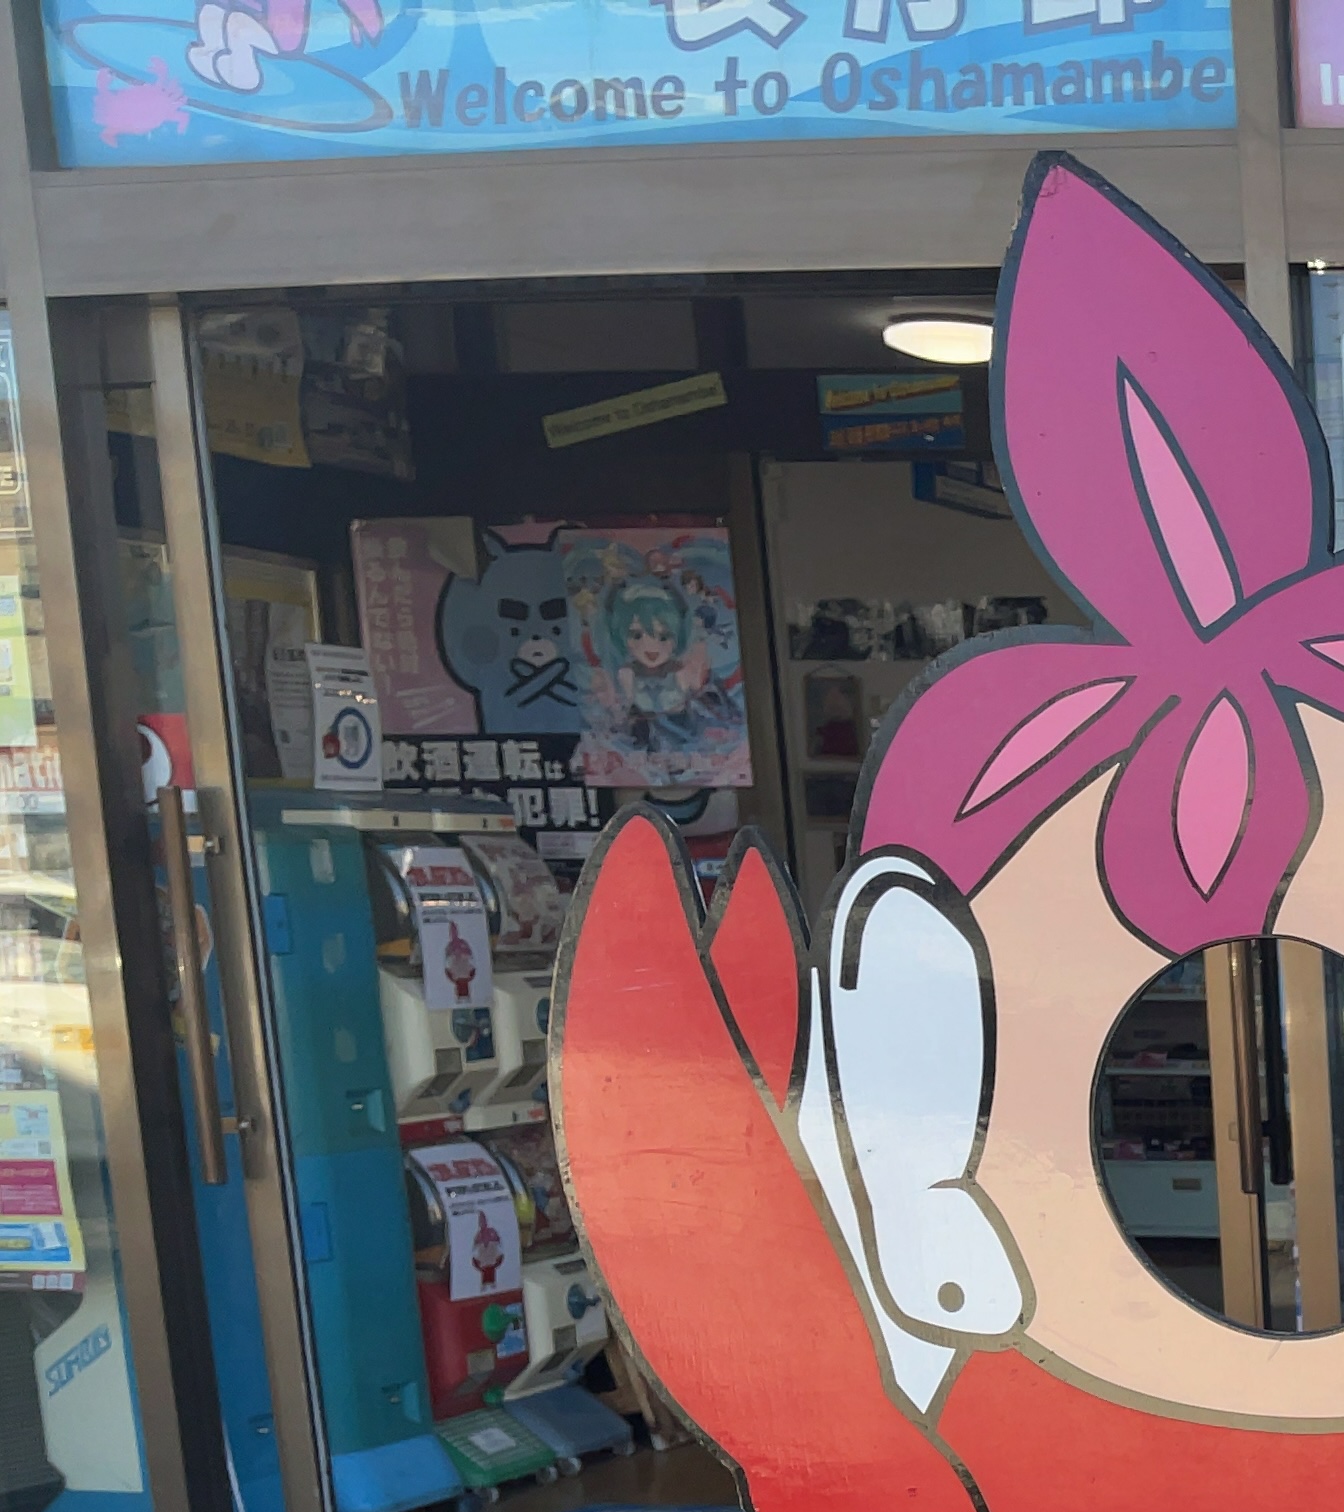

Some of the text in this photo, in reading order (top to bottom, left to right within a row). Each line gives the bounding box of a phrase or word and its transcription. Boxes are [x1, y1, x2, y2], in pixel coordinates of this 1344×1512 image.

[399, 41, 1226, 129] Welcome to Oshamambe
